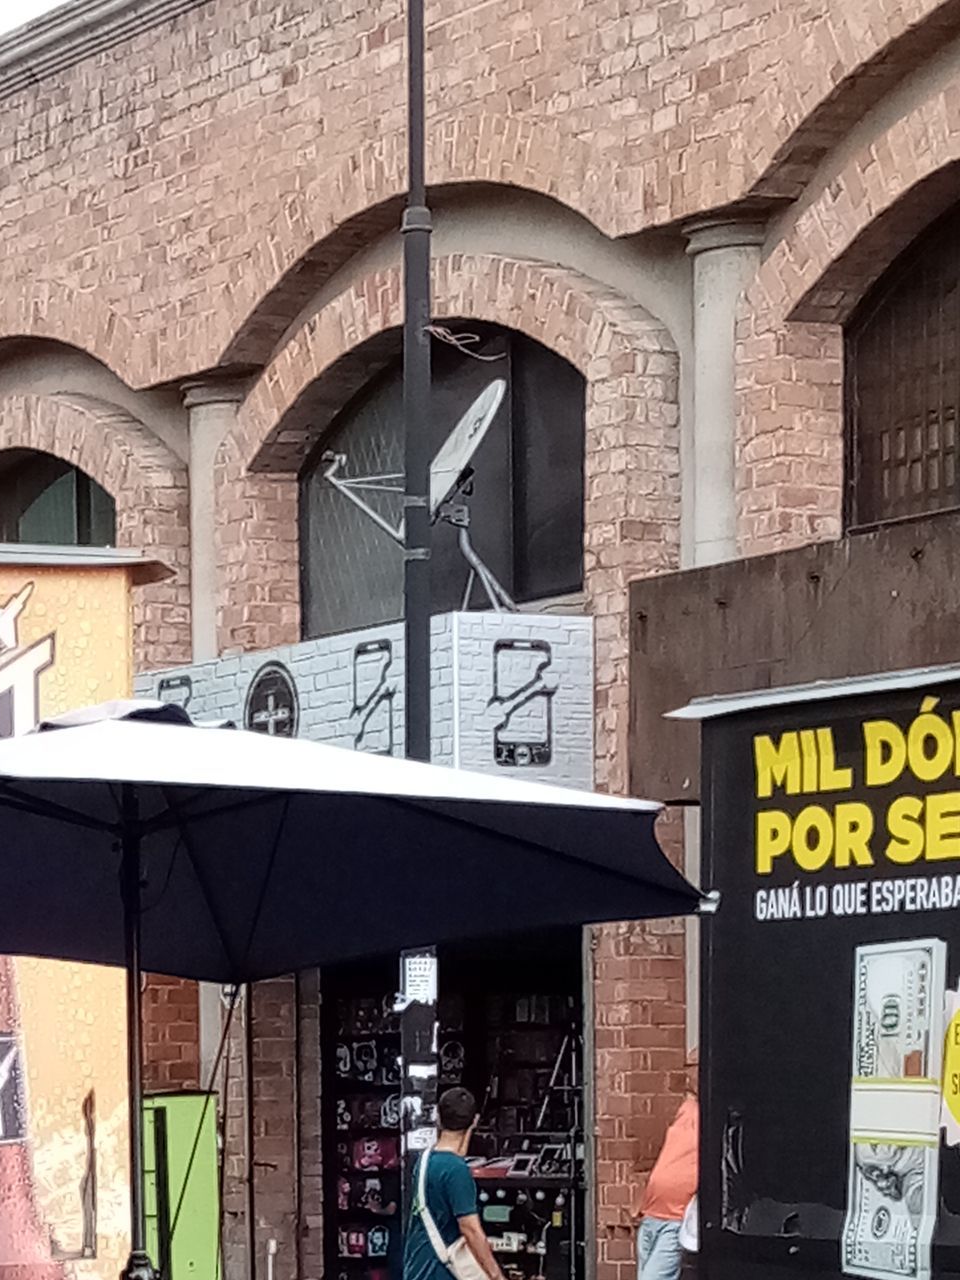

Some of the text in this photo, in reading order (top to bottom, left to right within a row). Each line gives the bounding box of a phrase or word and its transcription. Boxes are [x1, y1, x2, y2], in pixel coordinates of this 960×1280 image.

[754, 695, 960, 798] MIL DÓ
[756, 802, 874, 875] POR
[756, 881, 801, 920] GANÁ
[805, 886, 827, 917] LO
[832, 882, 867, 916] QUE
